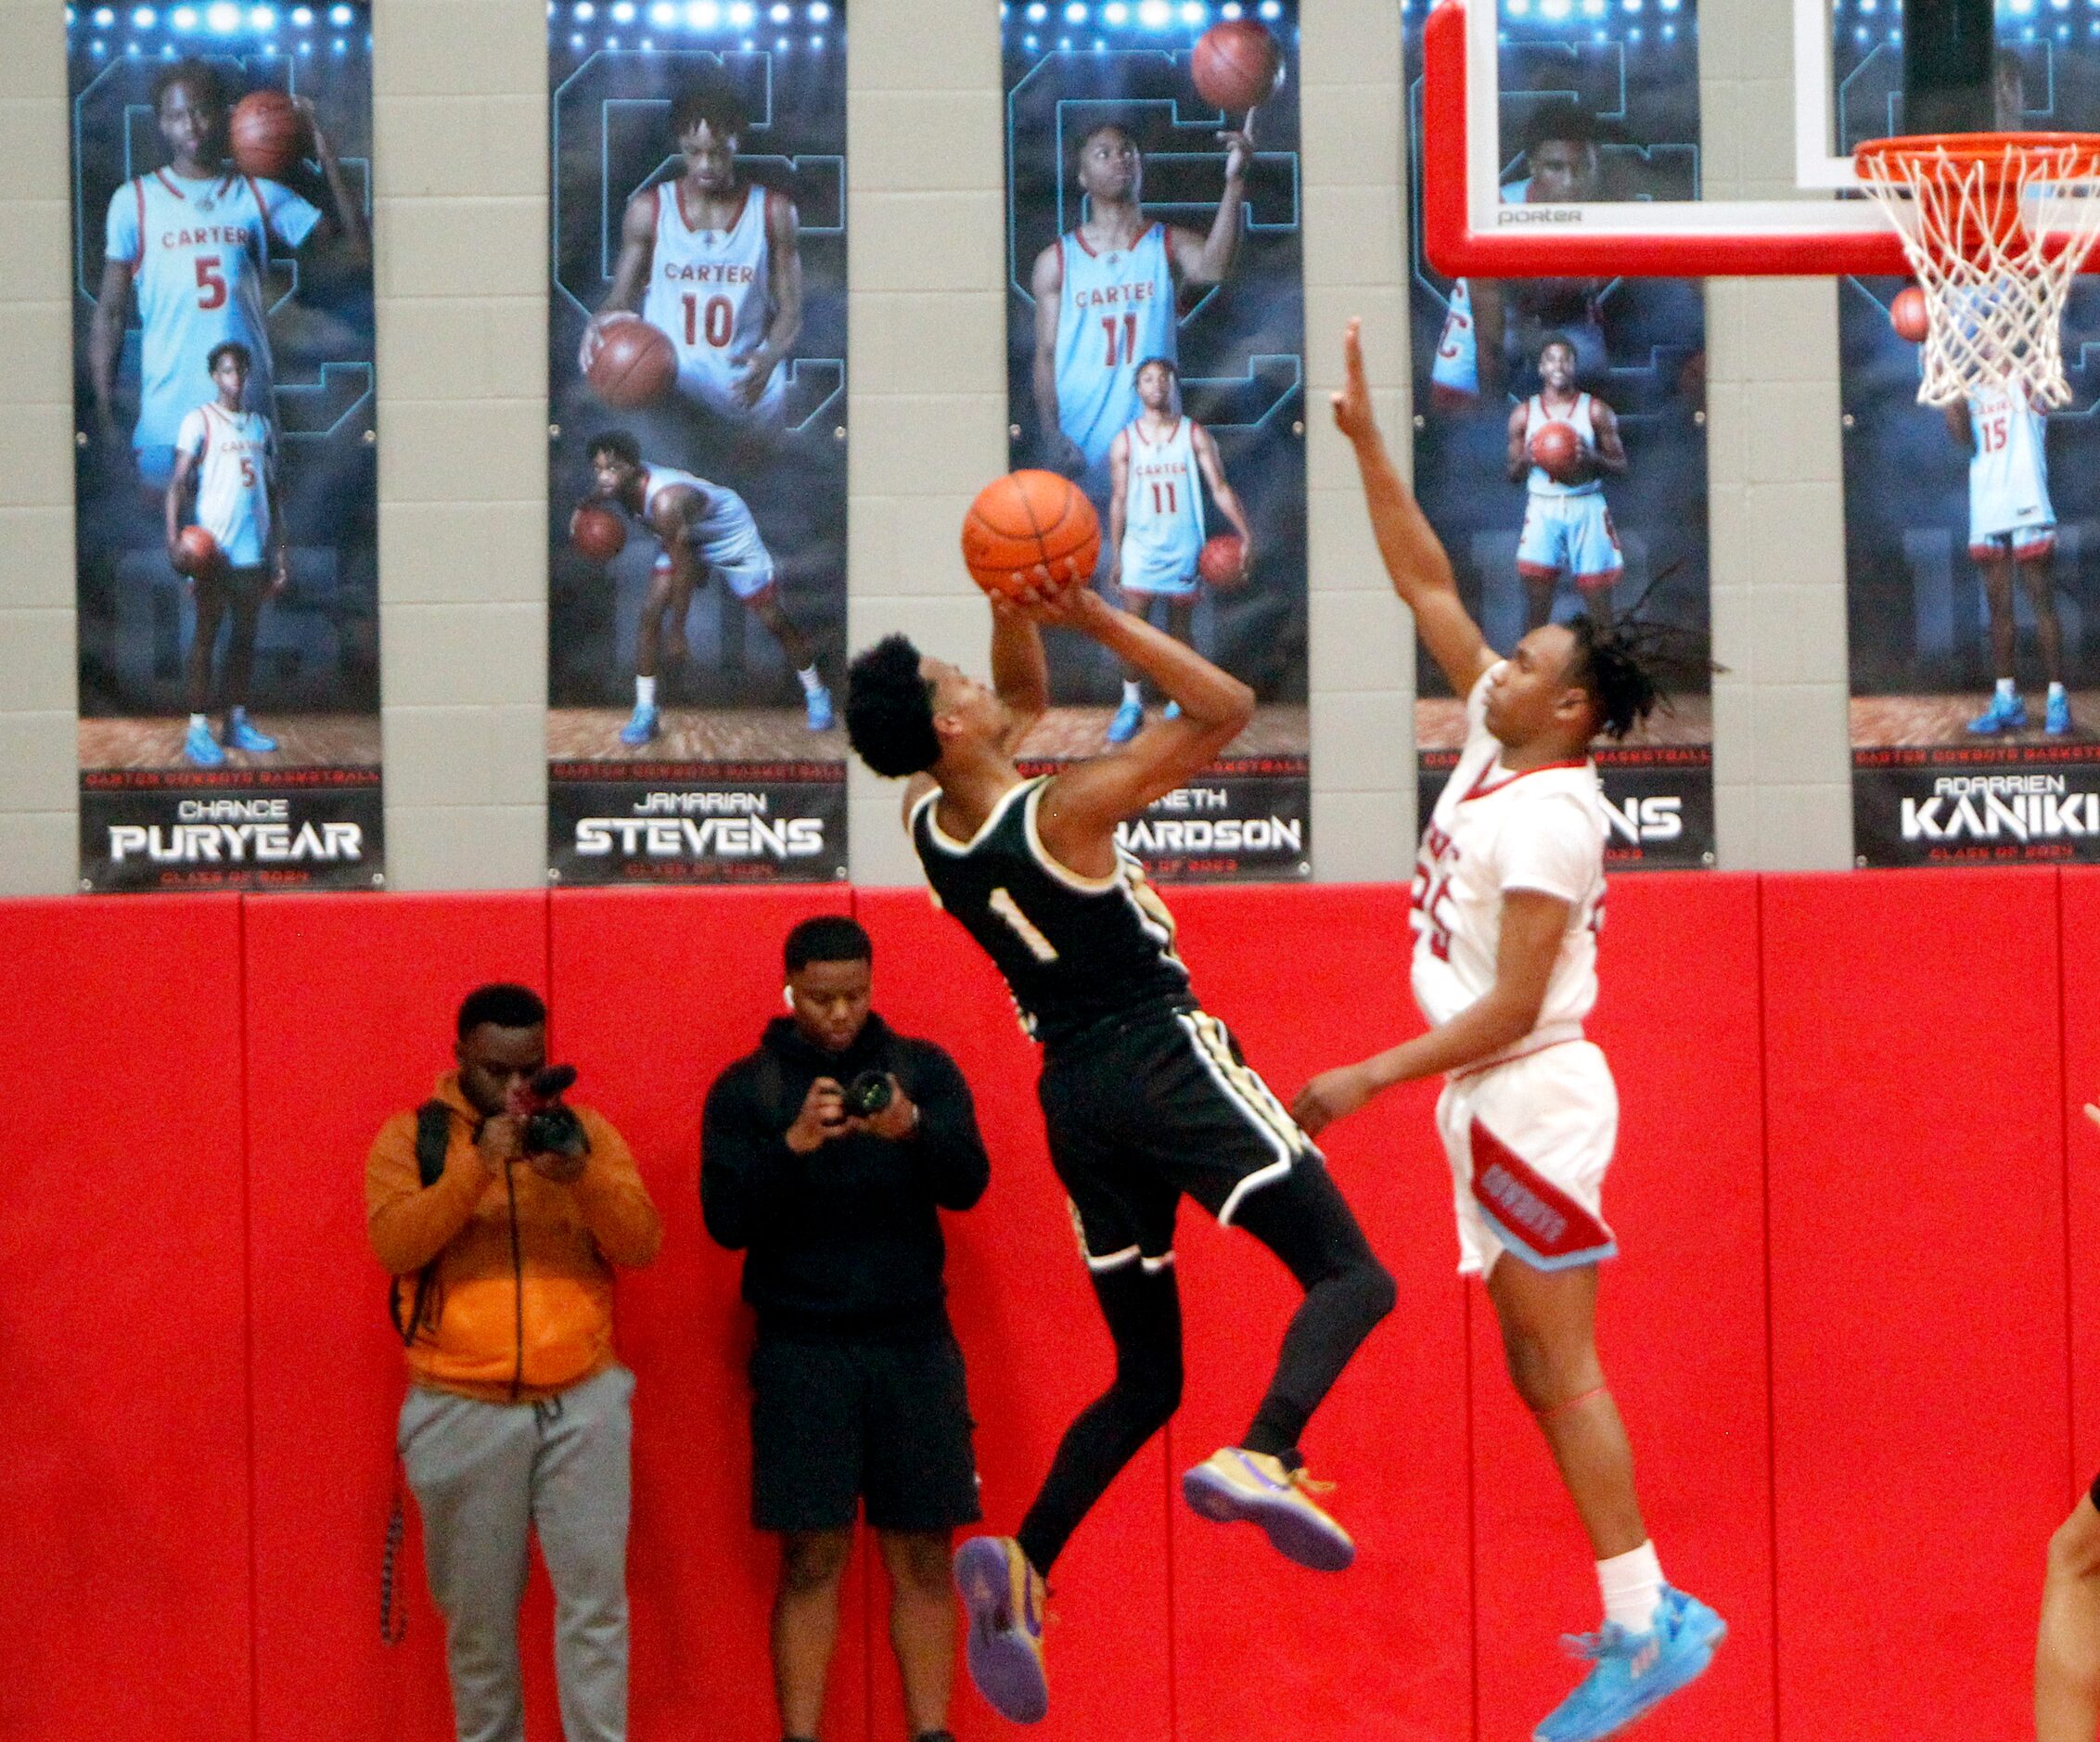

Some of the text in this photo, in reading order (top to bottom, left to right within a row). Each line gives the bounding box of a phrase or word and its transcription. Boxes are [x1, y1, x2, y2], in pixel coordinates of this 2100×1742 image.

[161, 225, 249, 250] CARTER
[194, 255, 228, 311] 5
[664, 263, 756, 285] CARTER
[681, 291, 734, 349] 10
[1102, 312, 1138, 367] 11
[1981, 416, 2007, 454] 15
[240, 456, 257, 488] 5
[1134, 464, 1187, 477] CARTER
[1151, 481, 1177, 514] 11
[634, 792, 768, 813] JAMARIAN
[1935, 774, 2065, 796] ADARRIEN
[177, 798, 288, 819] CHANCE
[1902, 792, 2100, 839] KANIKI
[109, 820, 363, 862] PURYEAR
[575, 815, 825, 858] STEVENS
[988, 887, 1059, 962] 1
